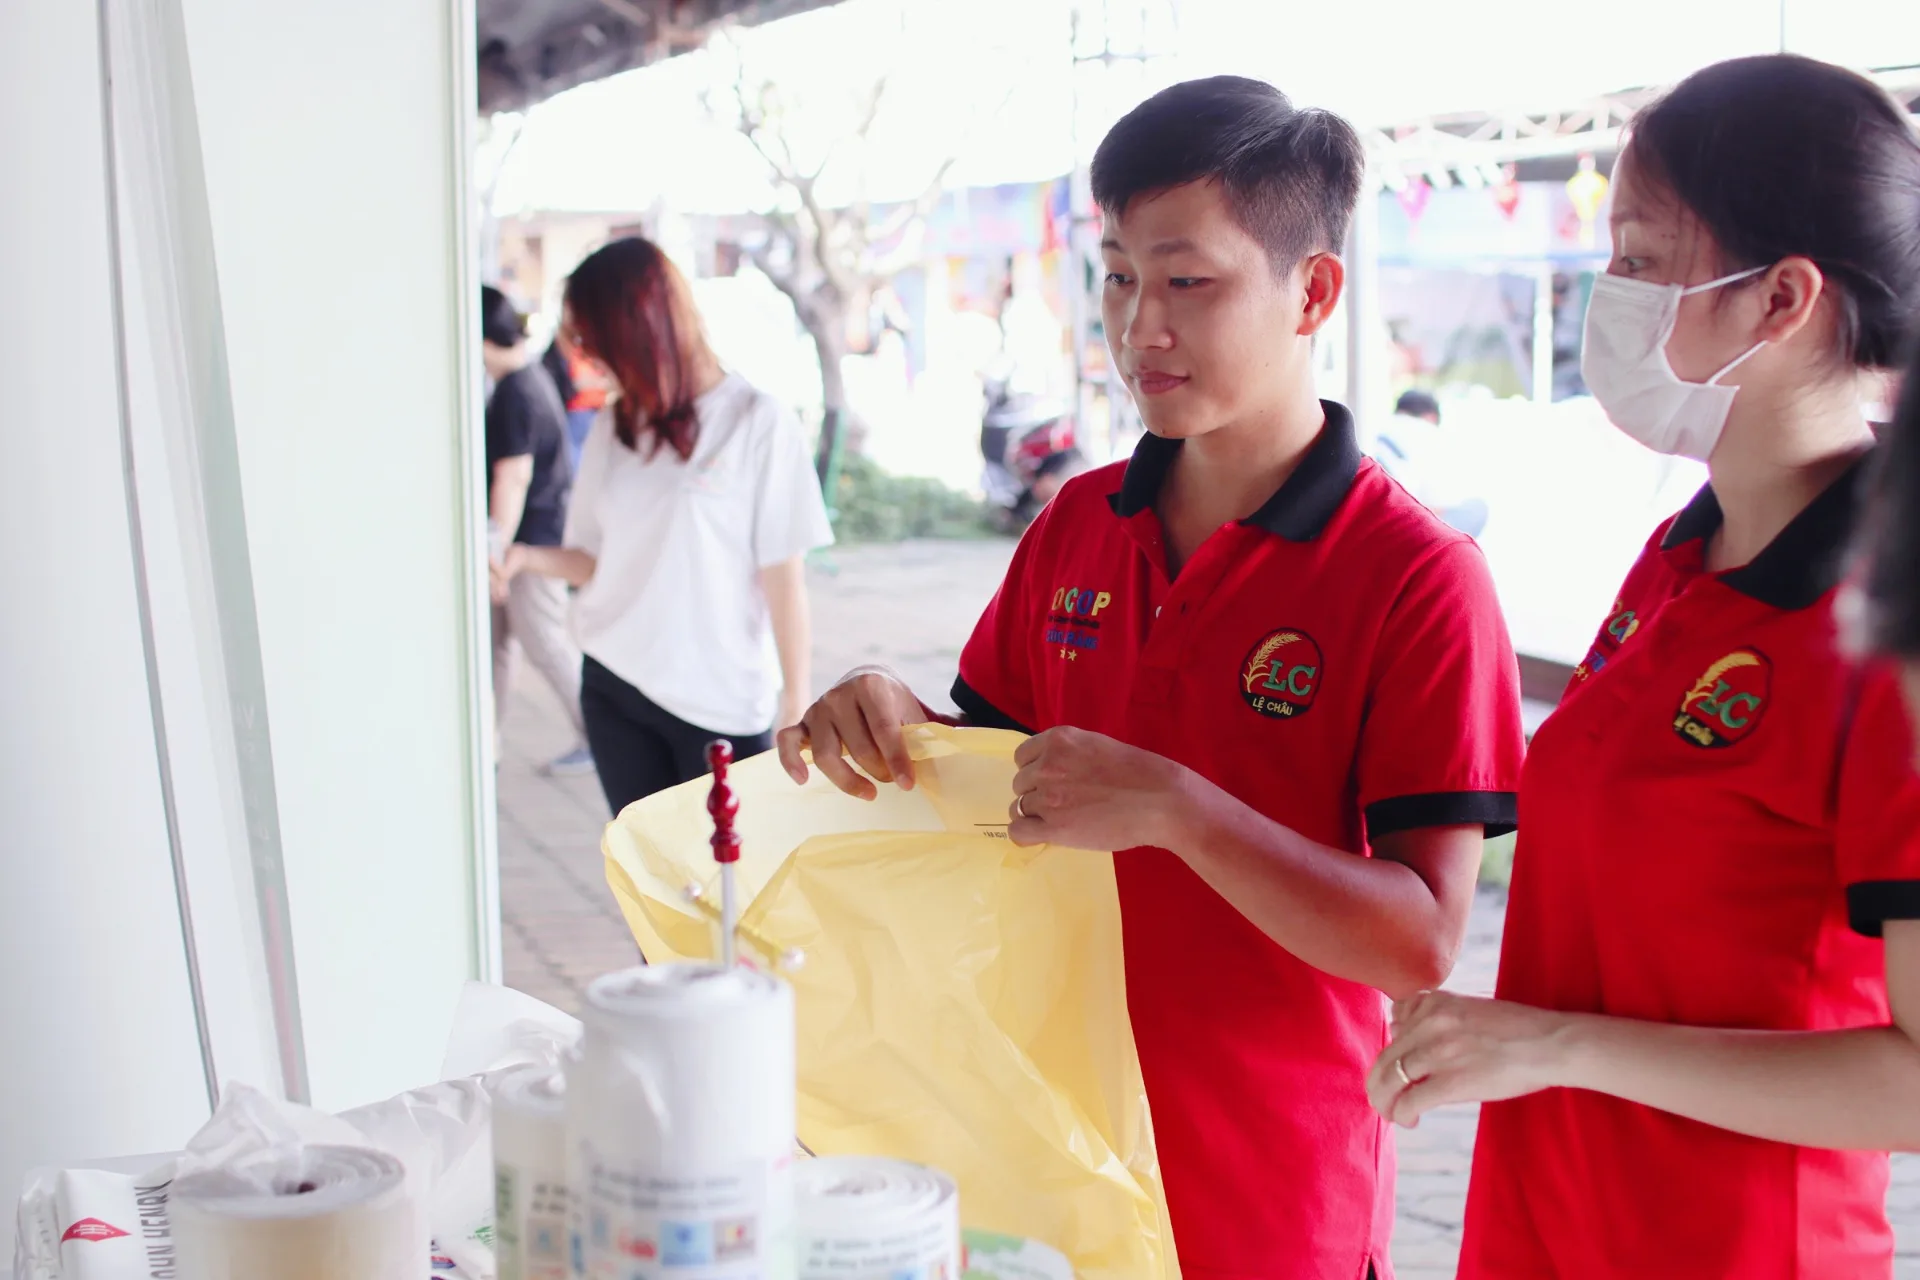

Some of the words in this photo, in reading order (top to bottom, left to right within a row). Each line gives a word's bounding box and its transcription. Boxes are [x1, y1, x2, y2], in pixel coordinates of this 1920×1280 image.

[1262, 659, 1316, 696] LC
[1252, 696, 1265, 712] LỆ
[1266, 700, 1293, 716] CHÂU
[1696, 679, 1762, 728] LC
[134, 1179, 173, 1238] HENRY
[146, 1245, 176, 1280] OHN
